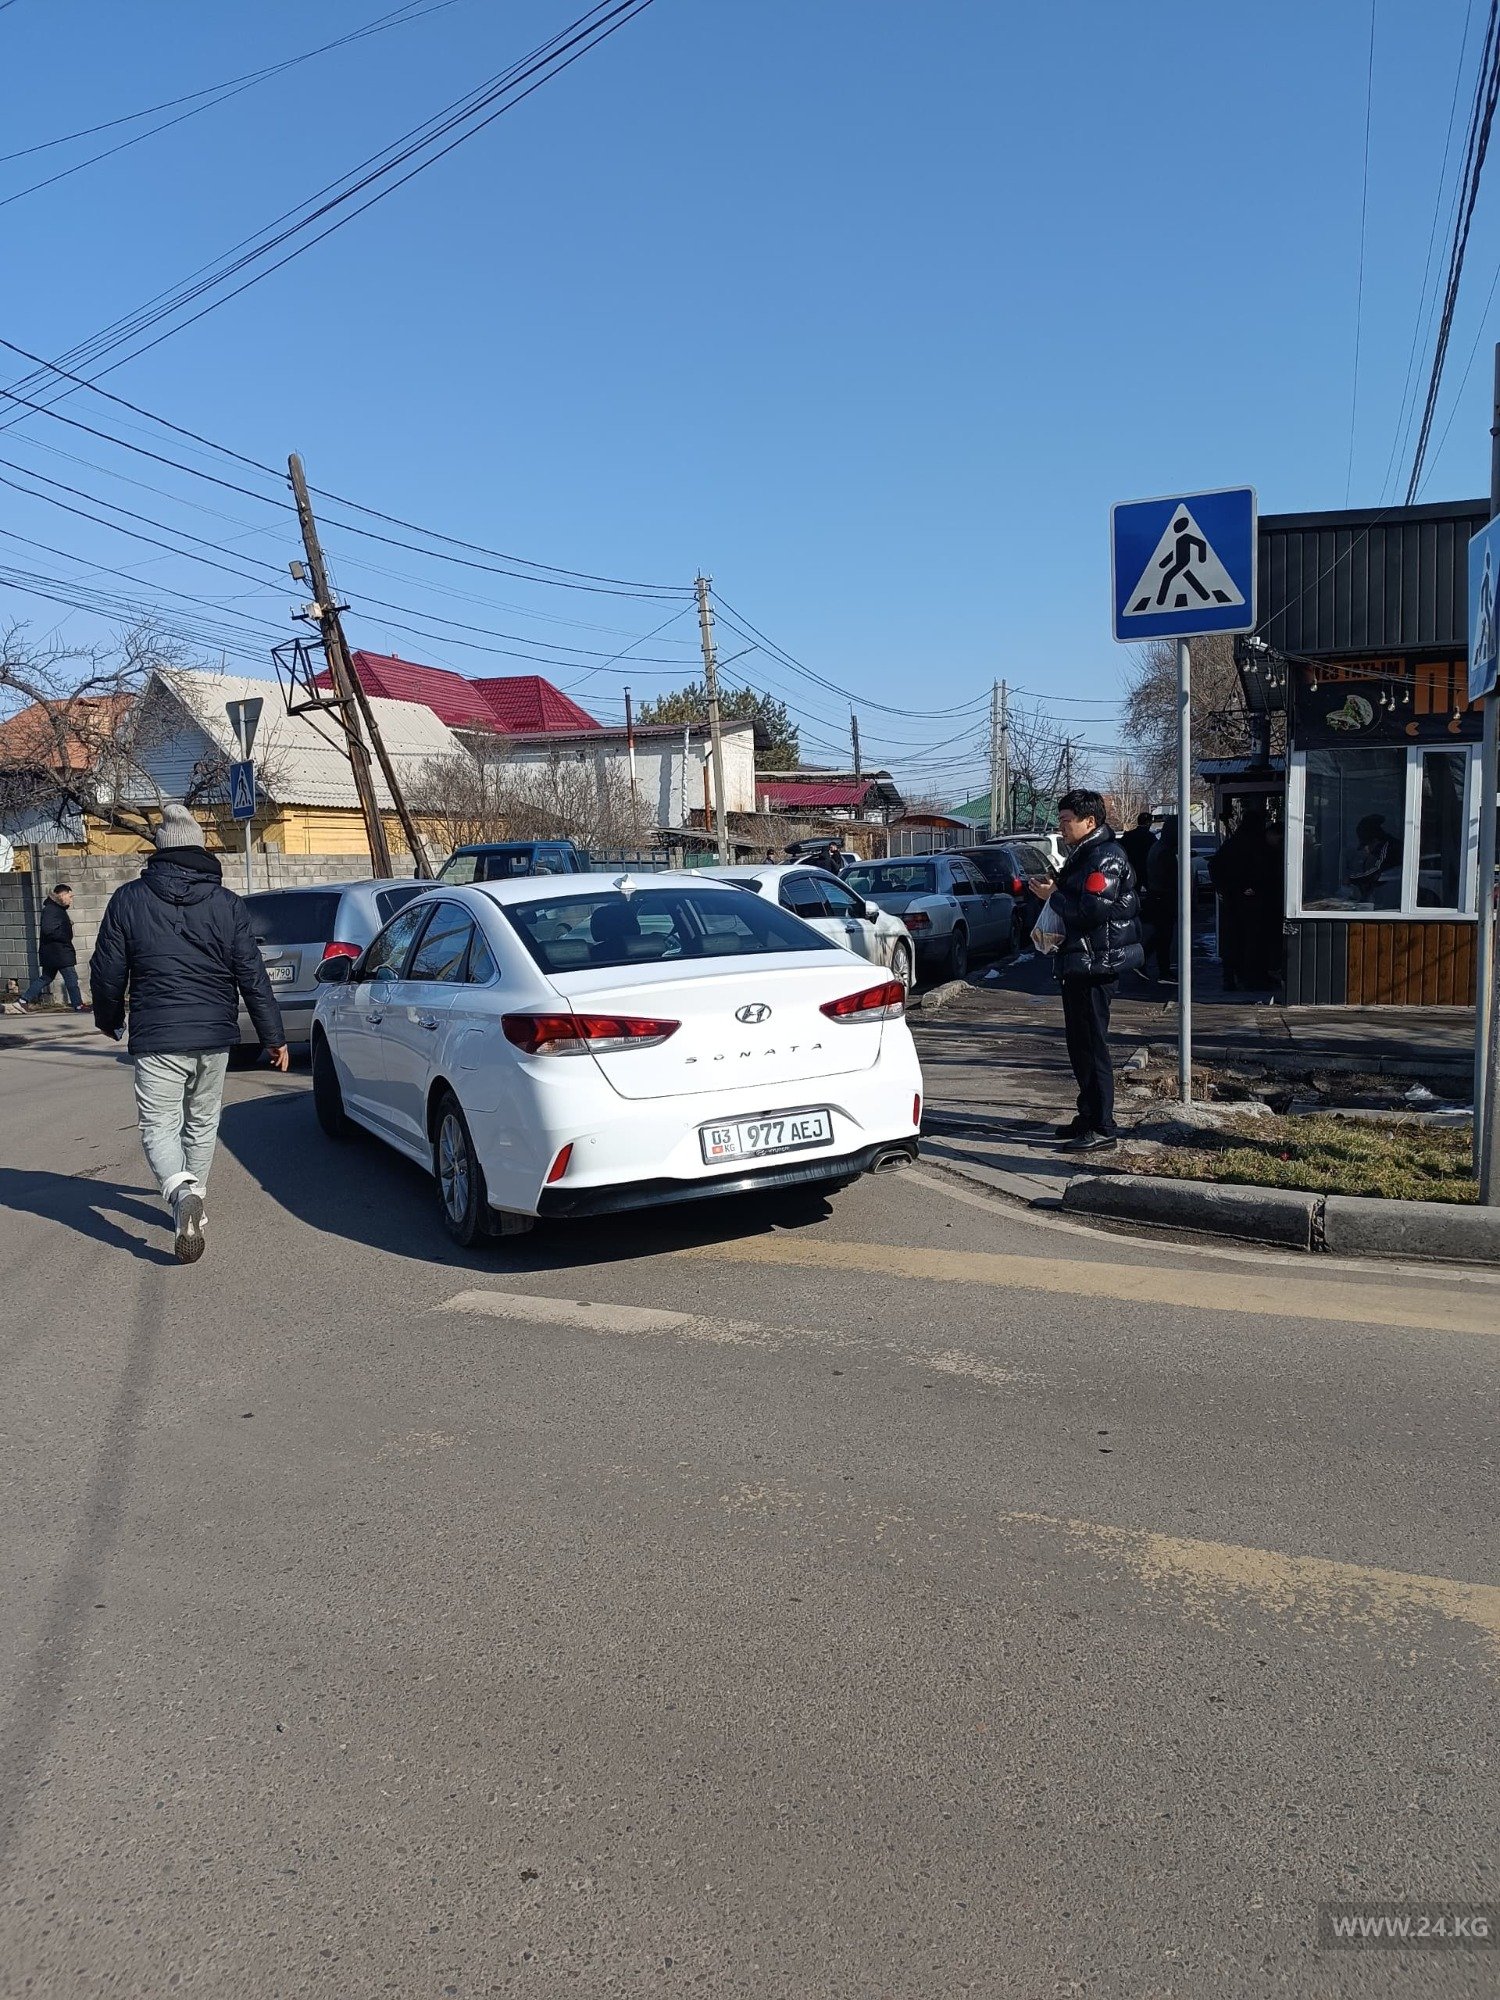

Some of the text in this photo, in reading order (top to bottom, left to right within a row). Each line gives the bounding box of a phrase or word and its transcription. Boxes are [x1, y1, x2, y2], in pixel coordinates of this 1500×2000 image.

[276, 968, 291, 977] 790
[685, 1043, 822, 1064] SONATA
[711, 1119, 823, 1148] 03 977 AEJ
[724, 1144, 736, 1153] KG
